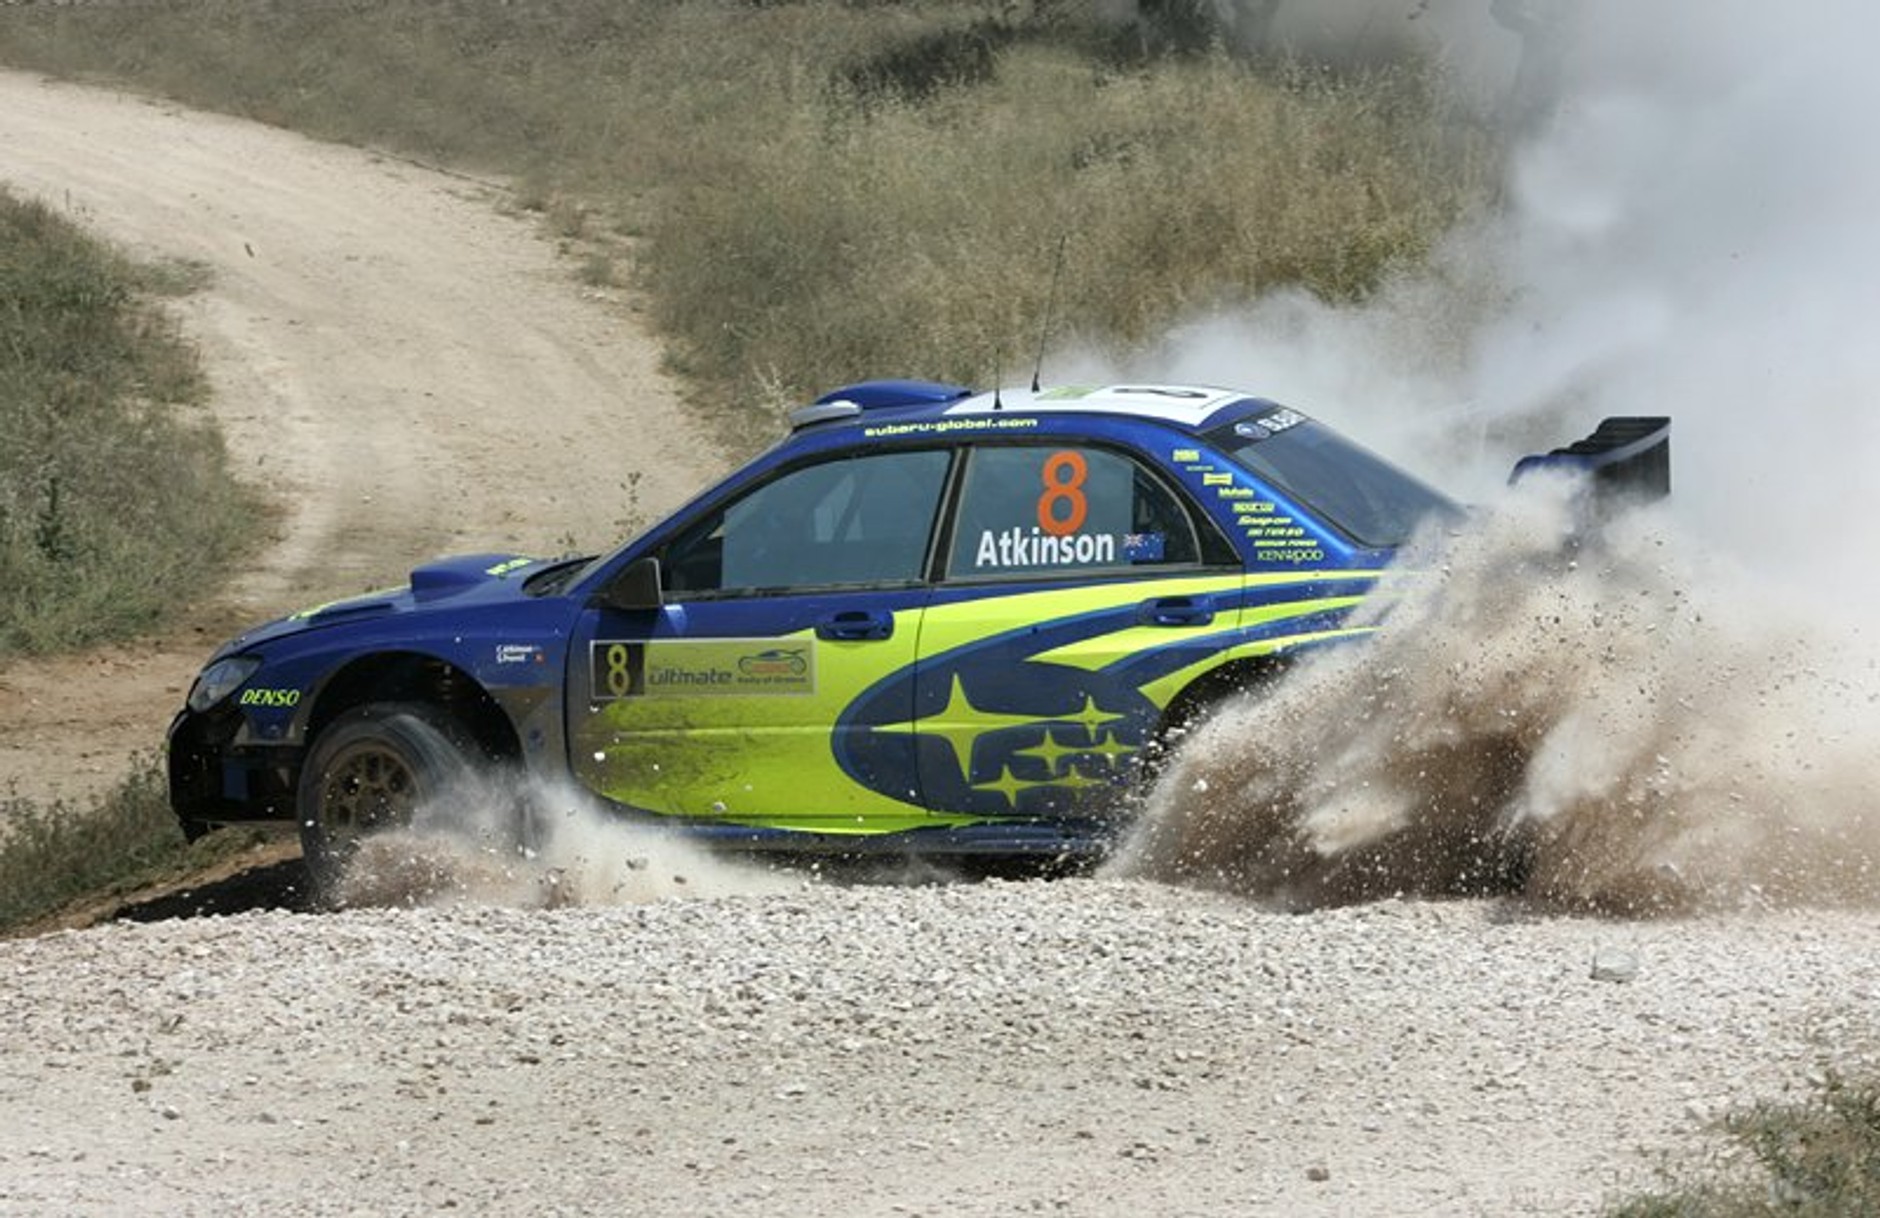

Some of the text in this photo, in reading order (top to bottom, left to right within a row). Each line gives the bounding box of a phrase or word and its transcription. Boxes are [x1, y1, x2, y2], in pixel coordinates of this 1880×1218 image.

[864, 418, 1038, 437] subaru-global.com
[1036, 450, 1089, 536] 8
[975, 526, 1114, 568] Atkinson
[1257, 549, 1325, 562] KENWOOD
[607, 643, 630, 697] 8
[650, 667, 733, 687] ultimate
[239, 688, 301, 706] DENSO
